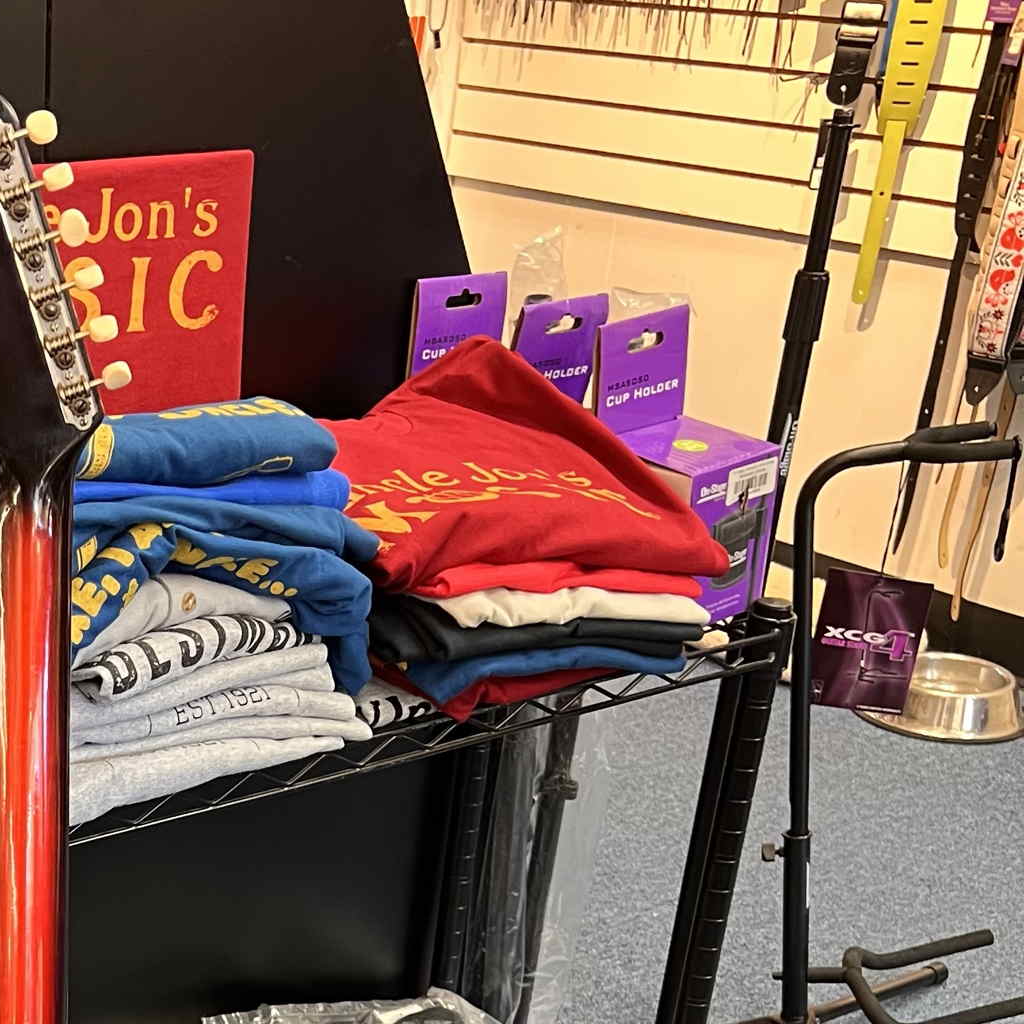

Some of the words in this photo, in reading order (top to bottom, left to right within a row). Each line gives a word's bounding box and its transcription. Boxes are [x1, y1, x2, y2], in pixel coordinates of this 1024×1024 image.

[84, 187, 218, 244] Jon's
[633, 378, 679, 400] HOLDER
[176, 690, 217, 726] EST
